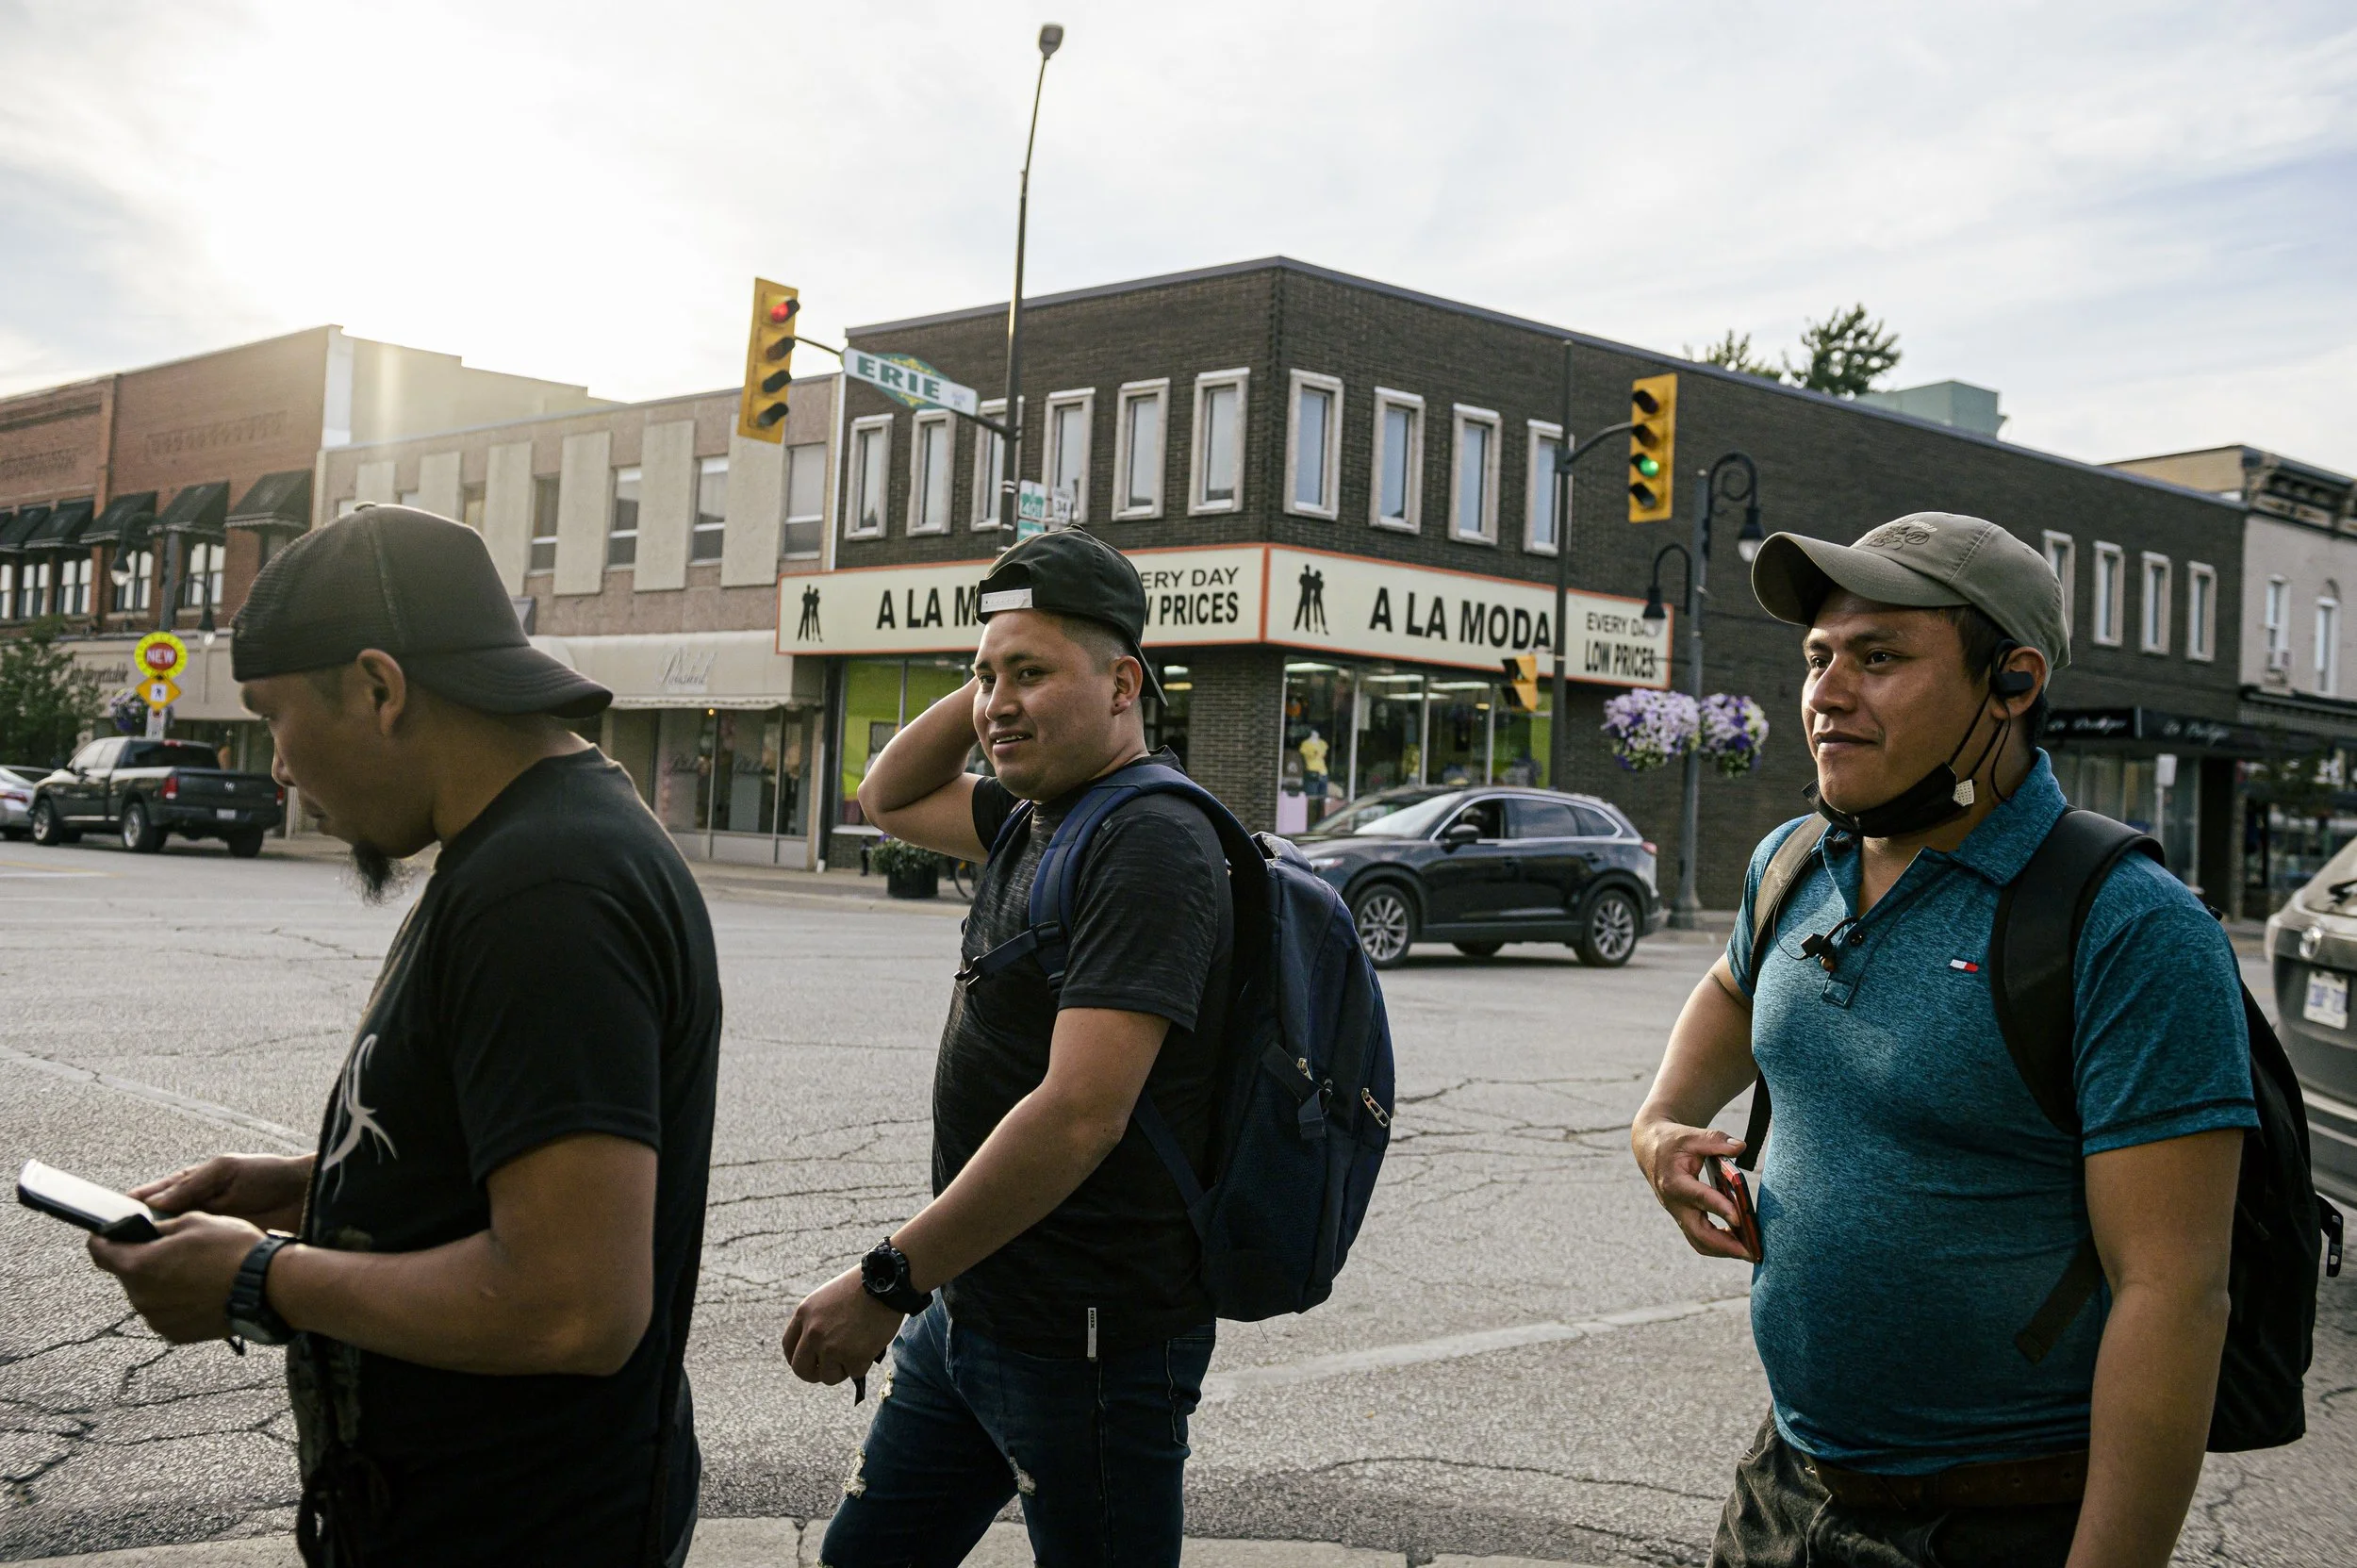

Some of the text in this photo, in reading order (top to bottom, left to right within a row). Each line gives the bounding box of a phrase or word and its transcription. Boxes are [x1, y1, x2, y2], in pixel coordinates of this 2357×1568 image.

[857, 355, 941, 400] ERIE
[1141, 567, 1239, 589] ERY DAY
[876, 589, 896, 630] A
[906, 586, 944, 628] LA
[1159, 591, 1239, 626] PRICES
[1369, 586, 1551, 650] A LA MODA
[1586, 611, 1629, 635] EVERY
[146, 648, 176, 665] NEW
[1585, 638, 1656, 679] LOW PRICES
